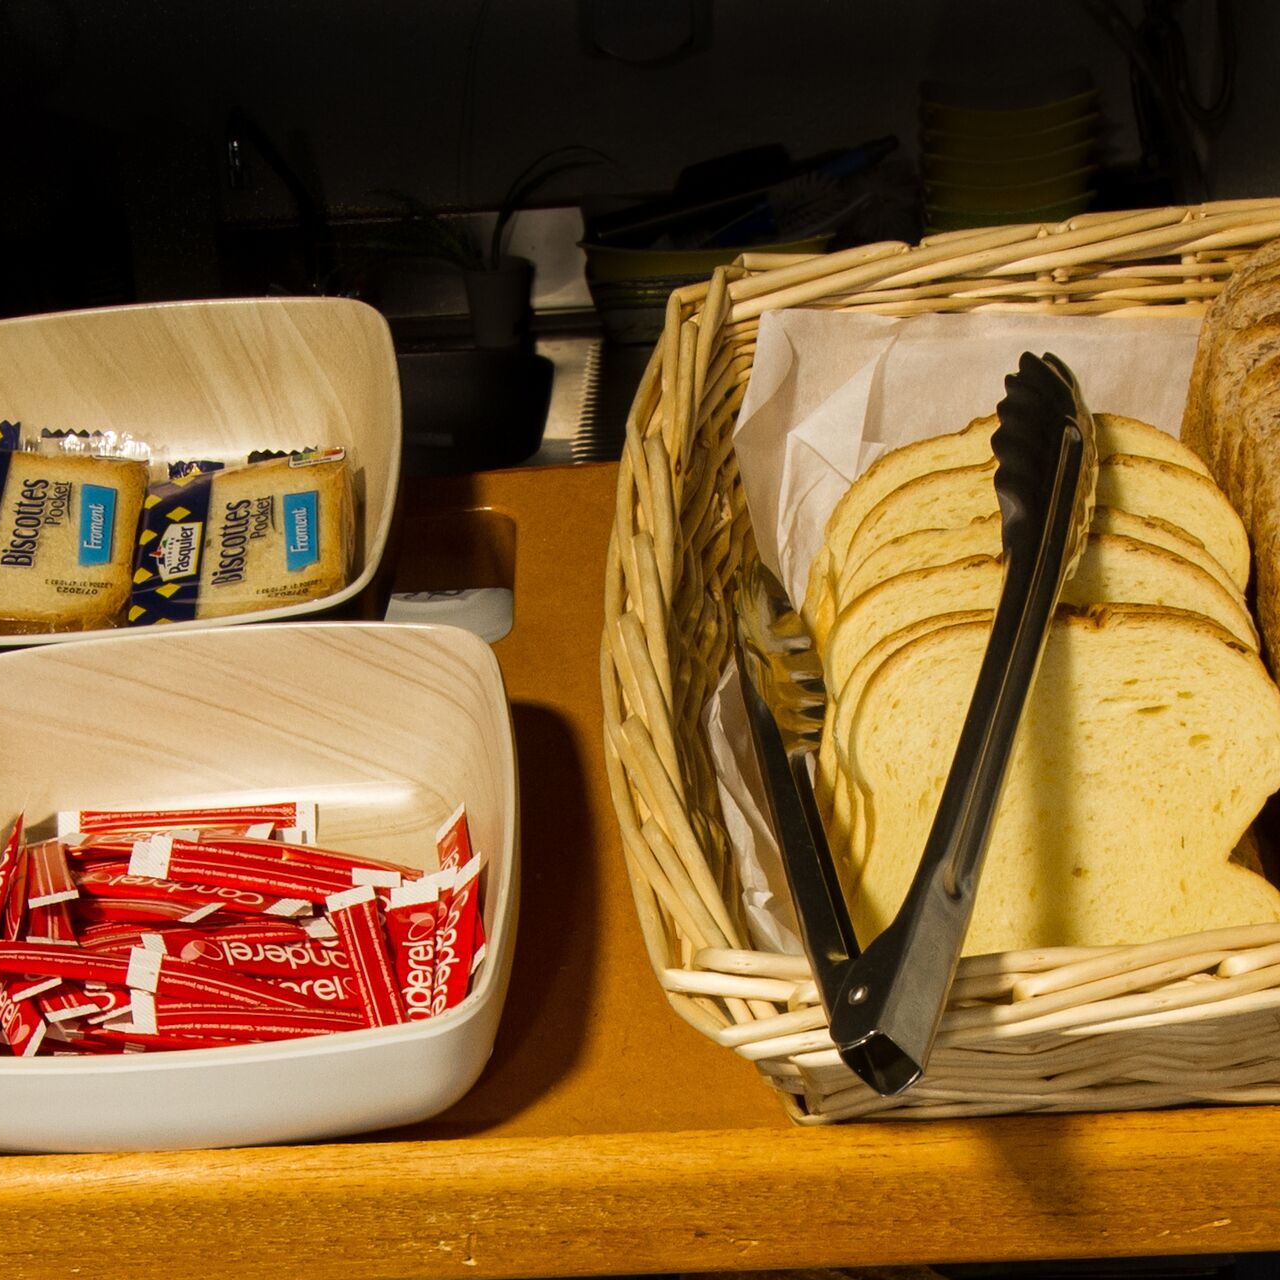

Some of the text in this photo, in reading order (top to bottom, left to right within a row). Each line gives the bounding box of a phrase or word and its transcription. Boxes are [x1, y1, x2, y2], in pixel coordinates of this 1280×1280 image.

[0, 478, 50, 567] Biscottes
[44, 481, 70, 526] Pocket
[83, 503, 105, 549] Froment
[249, 495, 271, 541] Pocket
[169, 525, 194, 575] Pasquier
[211, 498, 252, 586] Biscottes
[291, 507, 308, 553] Froment
